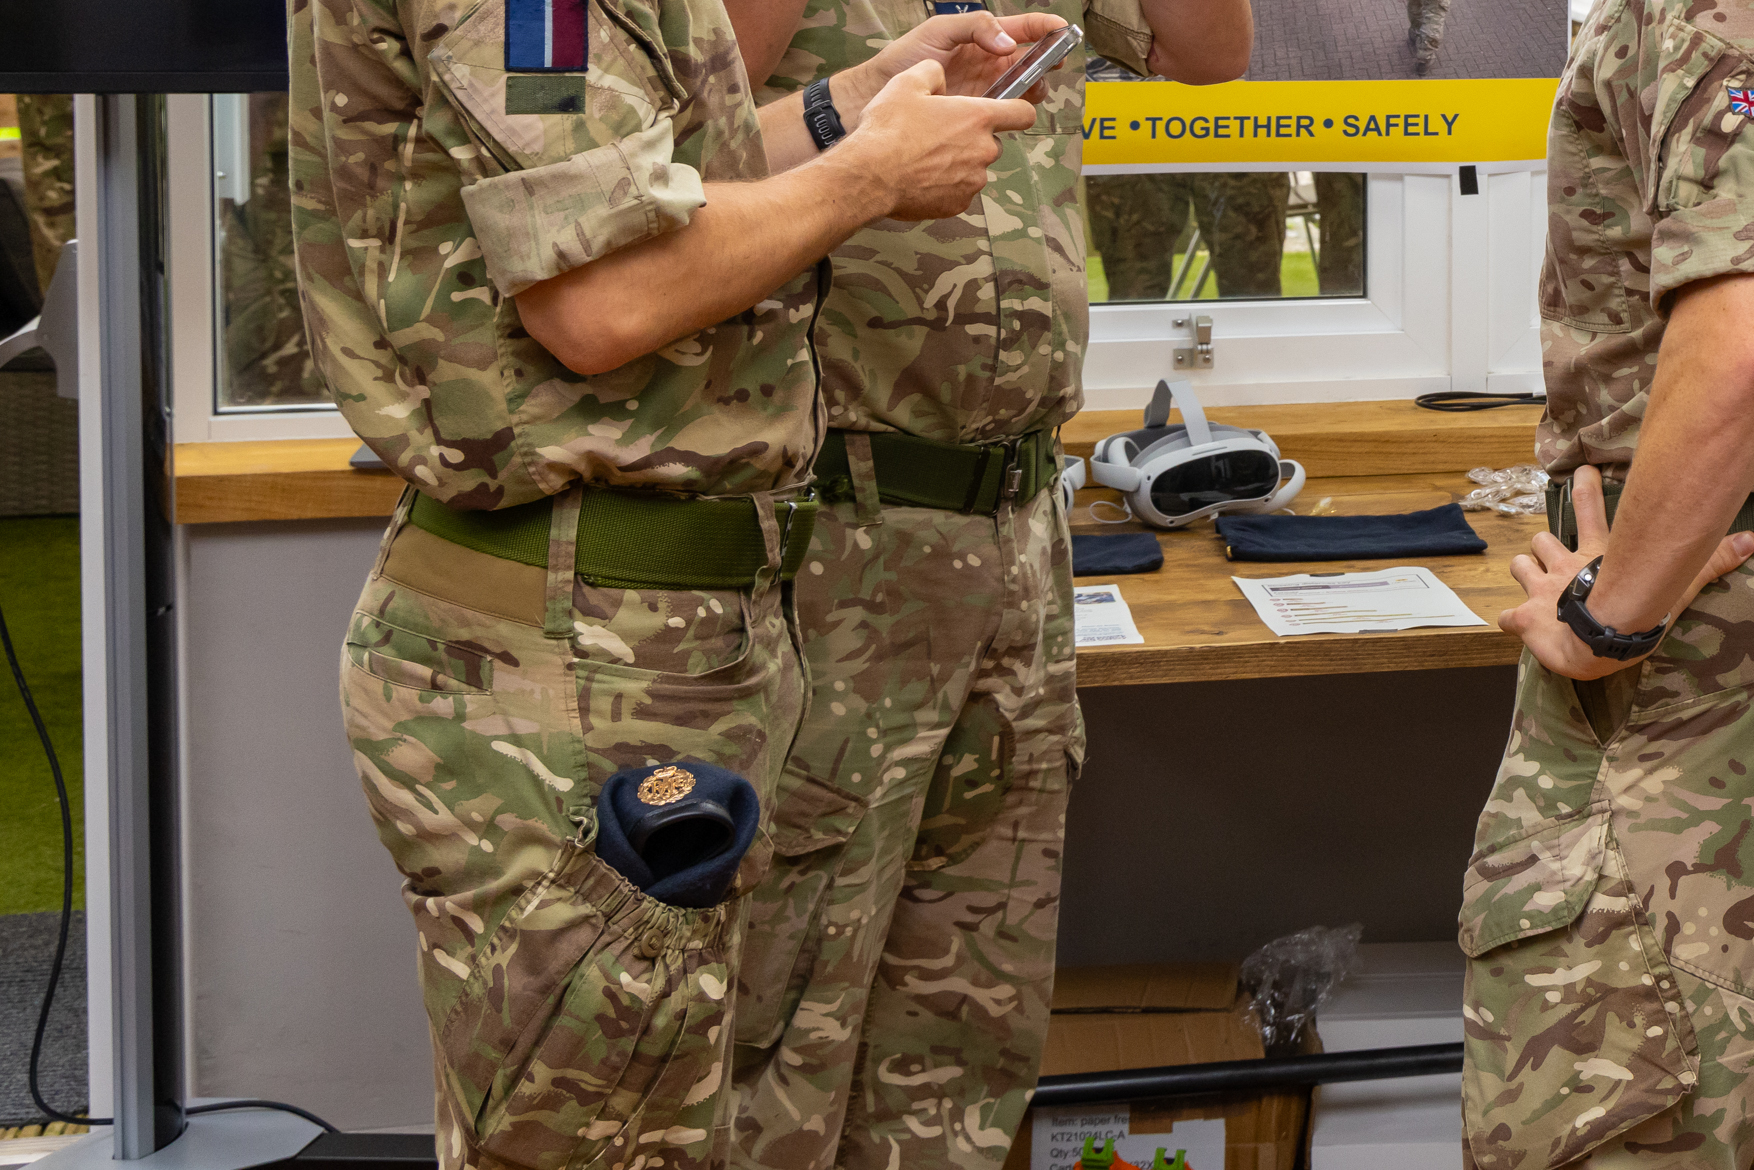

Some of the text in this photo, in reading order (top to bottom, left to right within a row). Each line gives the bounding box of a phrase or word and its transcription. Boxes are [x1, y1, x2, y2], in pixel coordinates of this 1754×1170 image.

[1144, 115, 1316, 139] TOGETHER
[1342, 113, 1460, 138] SAFELY
[1052, 1116, 1078, 1127] Item:
[1081, 1115, 1111, 1129] paper
